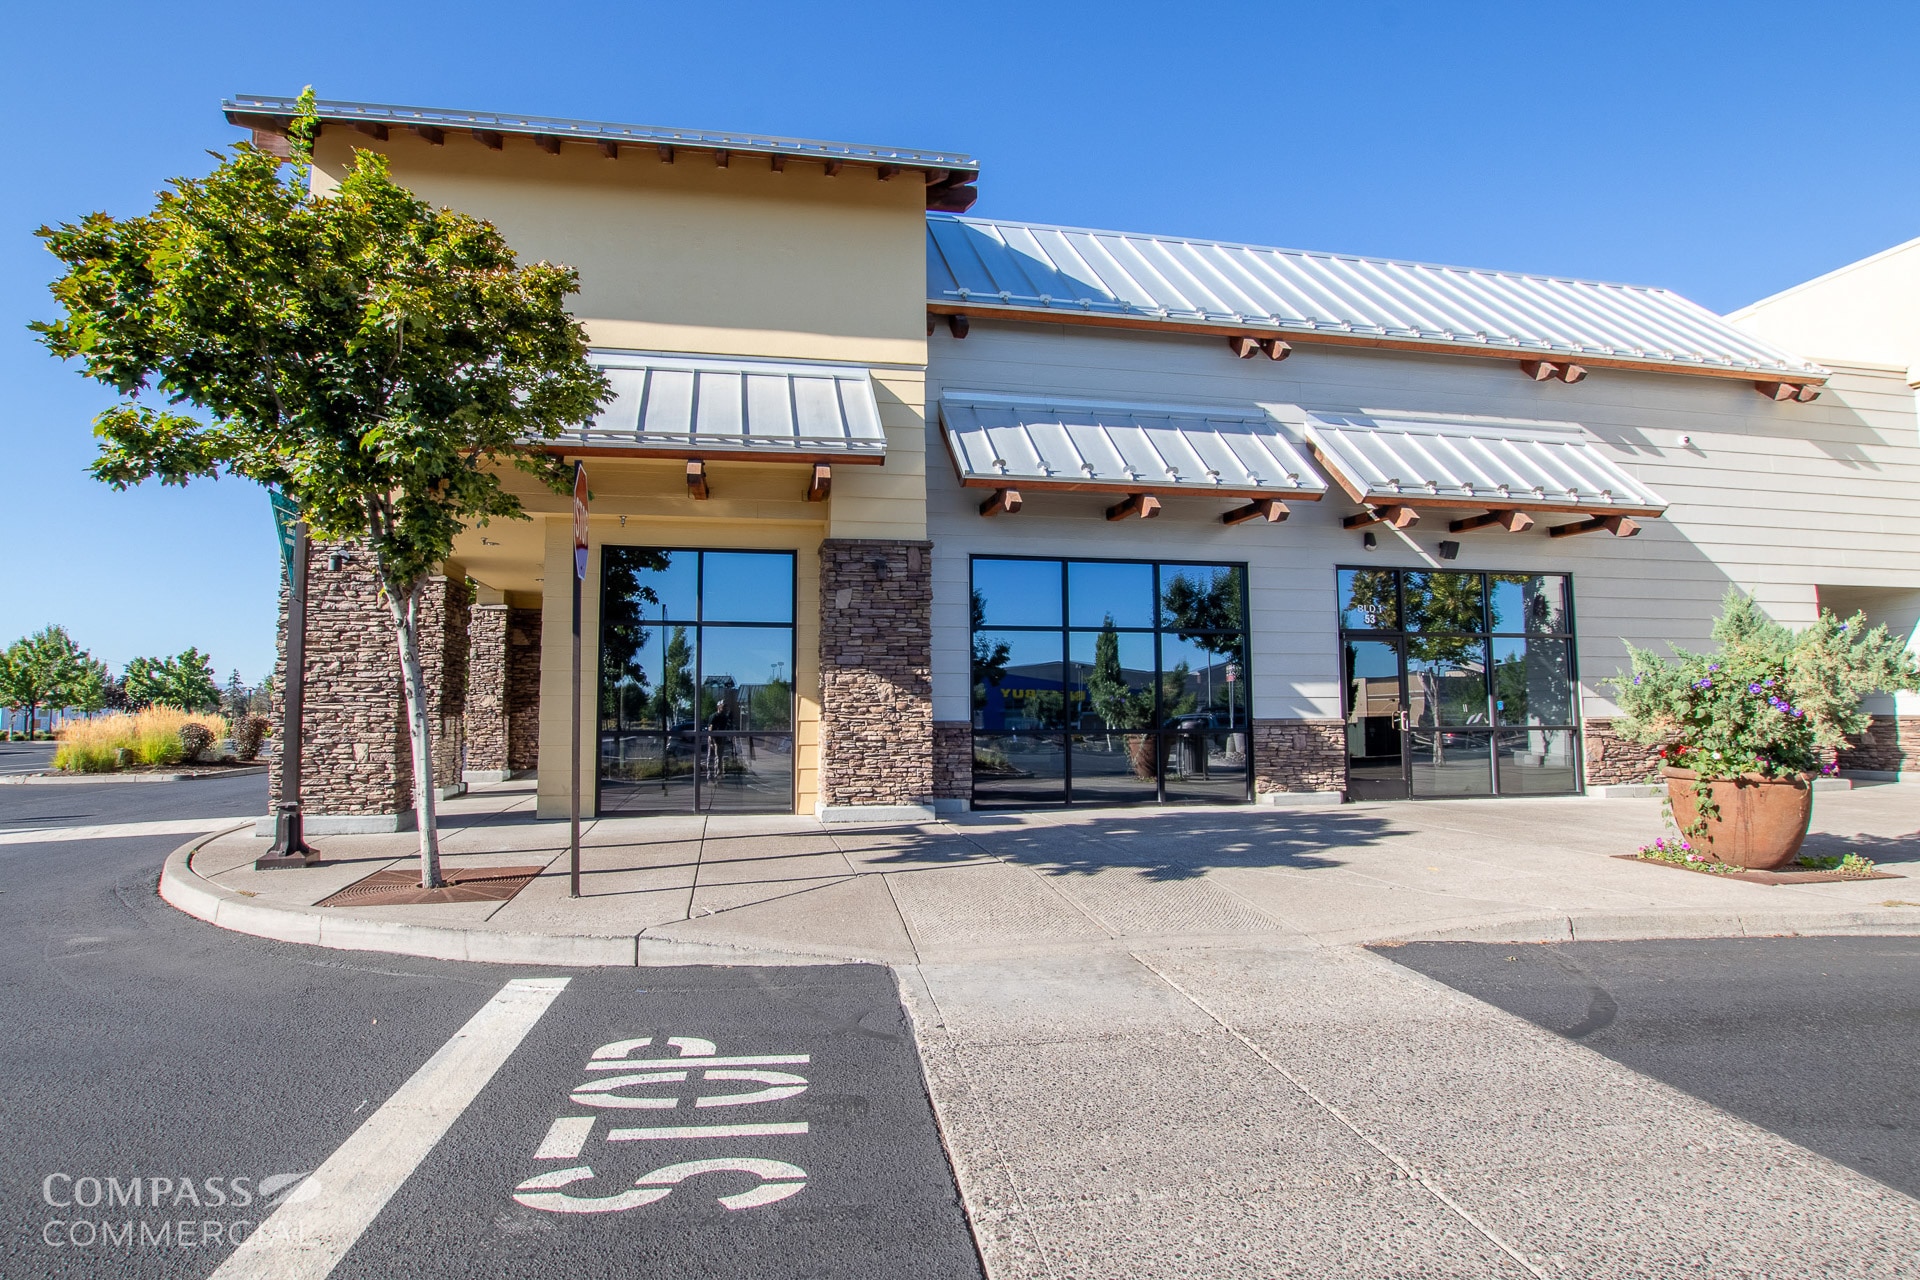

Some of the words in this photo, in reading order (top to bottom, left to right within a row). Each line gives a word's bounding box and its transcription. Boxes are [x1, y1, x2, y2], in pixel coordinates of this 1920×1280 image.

[574, 496, 588, 547] STOP
[1364, 614, 1376, 624] 53
[512, 1036, 810, 1213] STOP
